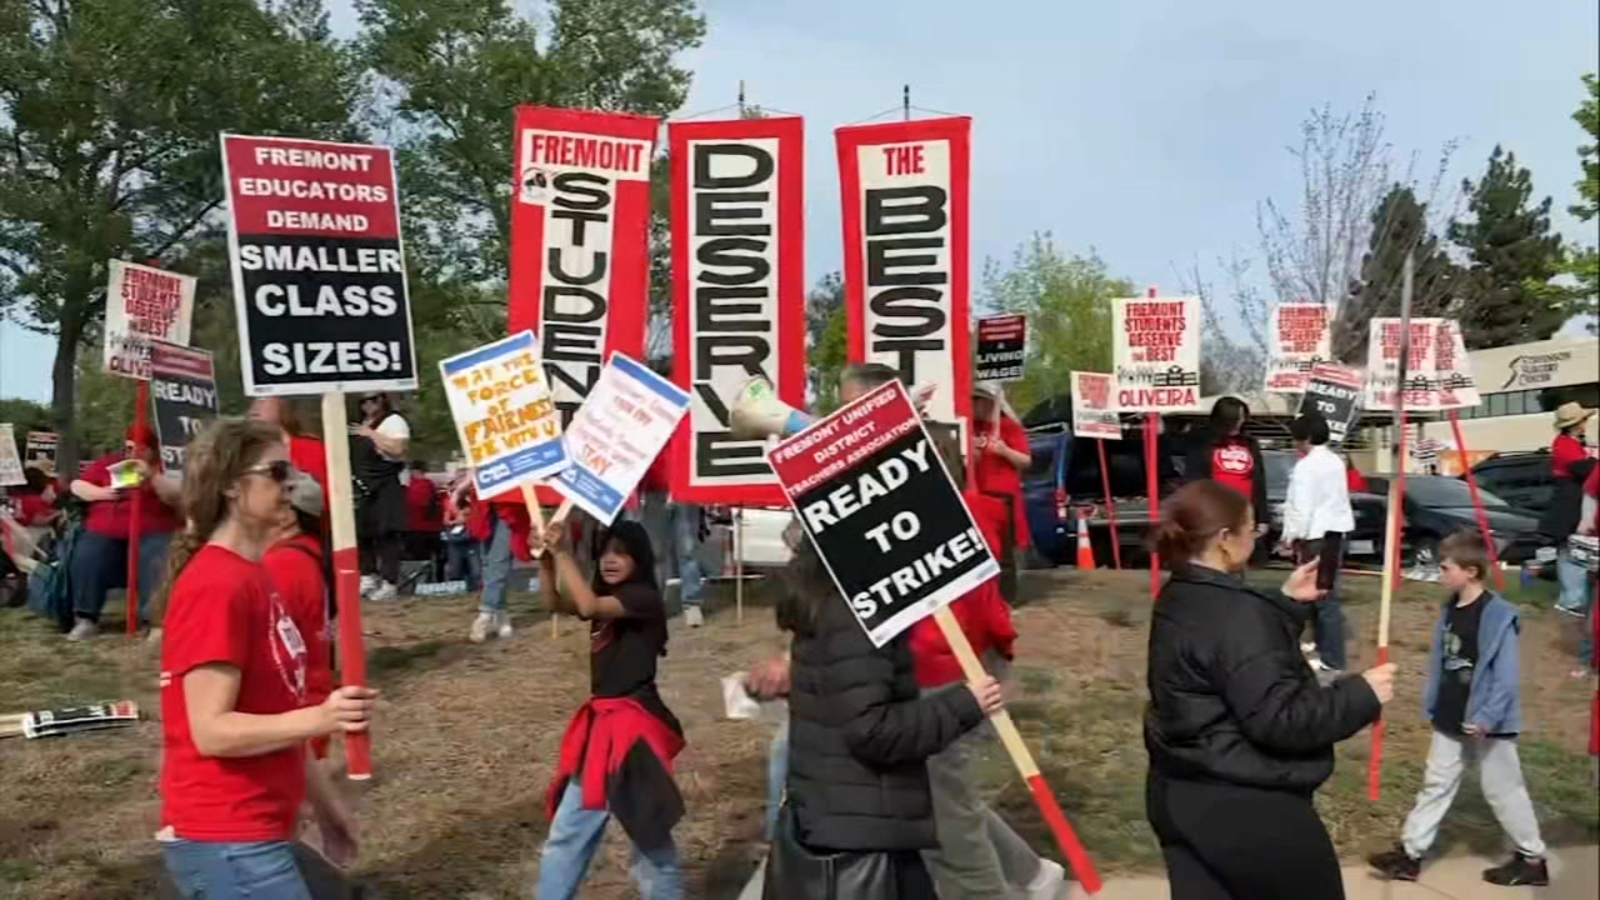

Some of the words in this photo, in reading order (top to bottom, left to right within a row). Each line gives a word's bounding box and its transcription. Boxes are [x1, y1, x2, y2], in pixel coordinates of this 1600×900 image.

[255, 147, 373, 171] FREMONT
[531, 134, 644, 172] FREMONT
[883, 146, 924, 176] THE
[238, 178, 388, 202] EDUCATORS
[267, 210, 369, 231] DEMAND
[240, 244, 402, 273] SMALLER
[255, 283, 398, 317] CLASS
[866, 185, 948, 386] BEST
[1126, 302, 1184, 317] FREMONT
[1125, 317, 1186, 332] STUDENTS
[1129, 332, 1183, 347] DESERVE
[1146, 347, 1176, 361] BEST
[109, 355, 153, 377] OLIVE
[262, 340, 402, 376] SIZES!
[976, 366, 1022, 378] WAGE
[154, 380, 215, 409] READY
[467, 369, 538, 405] FORCE
[1119, 388, 1196, 407] OLIVEIRA
[1308, 382, 1357, 400] READY
[488, 397, 509, 416] OF
[1317, 400, 1336, 413] TO
[774, 421, 841, 464] FREMONT
[842, 388, 897, 425] UNIFIED
[787, 459, 846, 496] TEACHERS
[846, 417, 918, 465] ASSOCIATION
[813, 421, 877, 464] DISTRICT
[802, 439, 931, 534] READY
[864, 511, 921, 554] TO
[852, 526, 985, 619] STRIKE!
